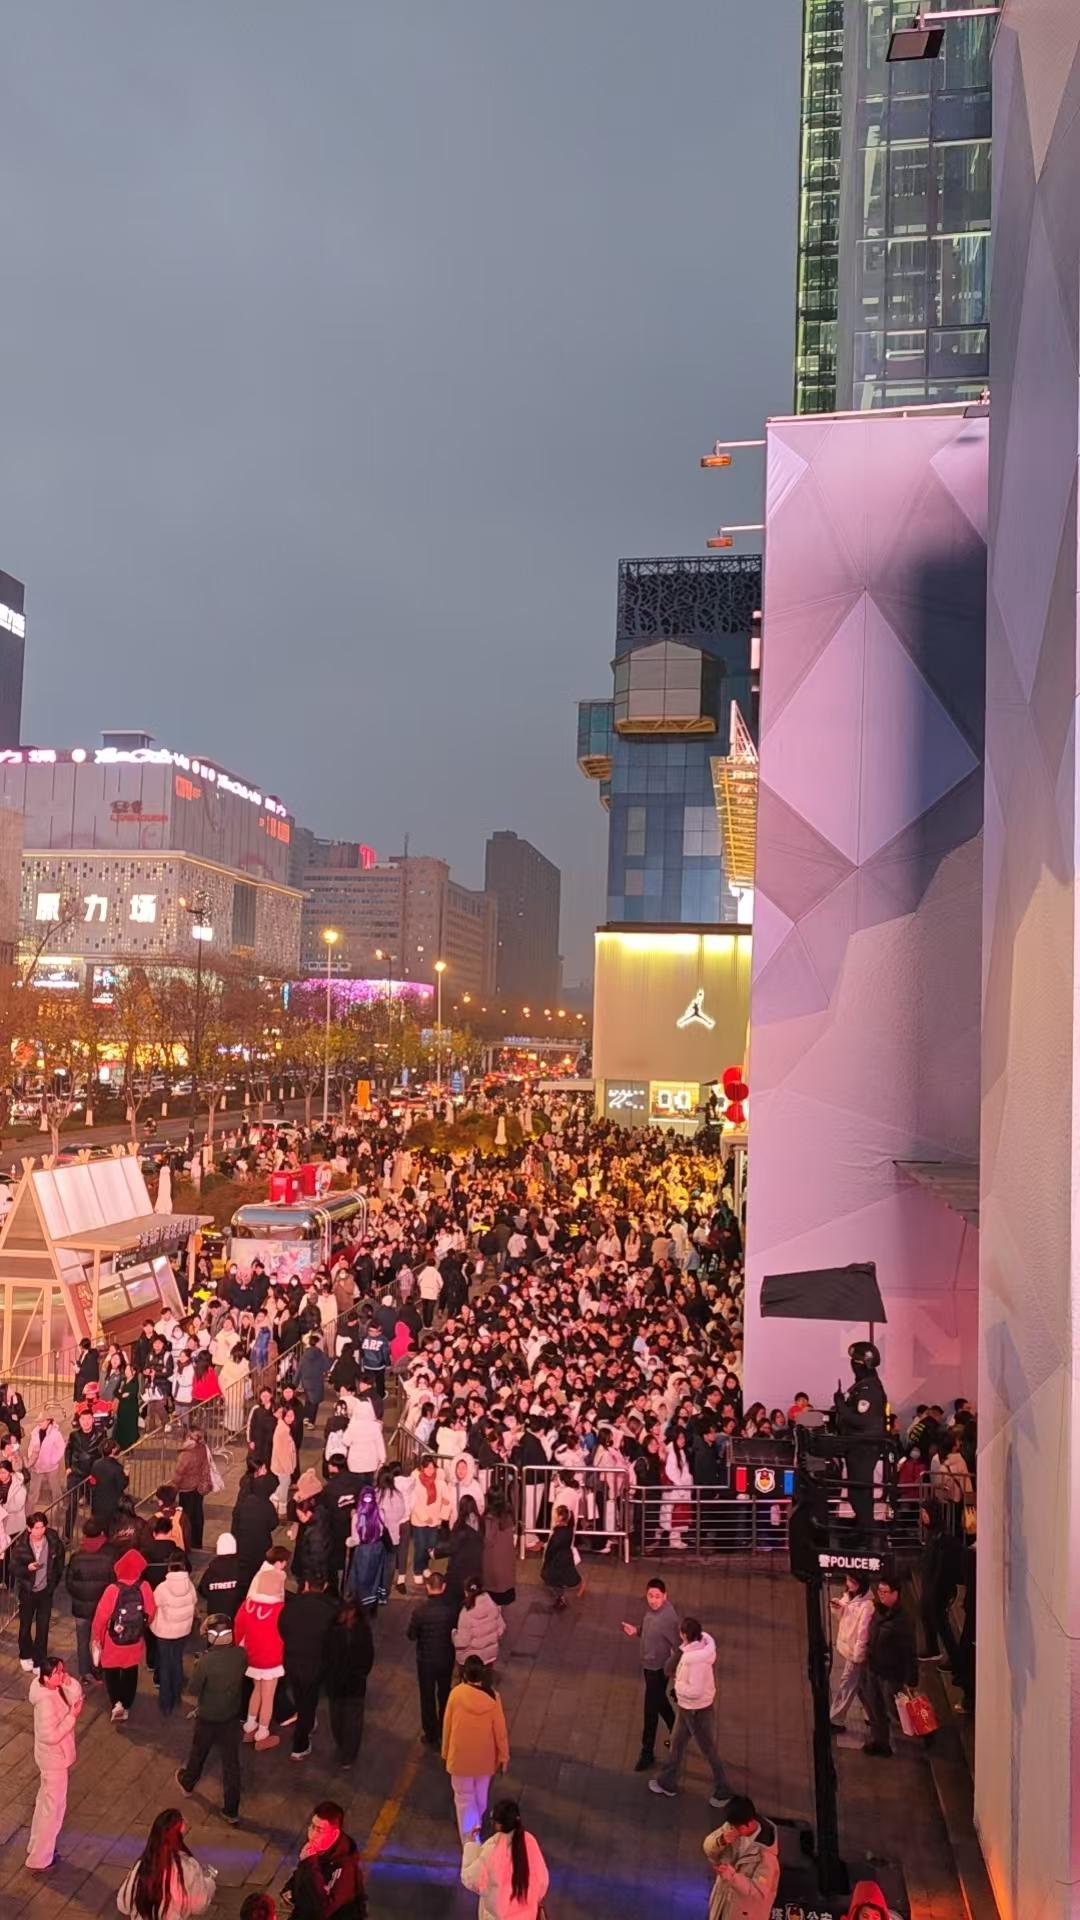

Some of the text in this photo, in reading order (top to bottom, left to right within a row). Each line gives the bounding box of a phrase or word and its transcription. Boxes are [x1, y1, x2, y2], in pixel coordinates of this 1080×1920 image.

[36, 893, 158, 923] 原力场
[208, 1580, 238, 1591] STREET
